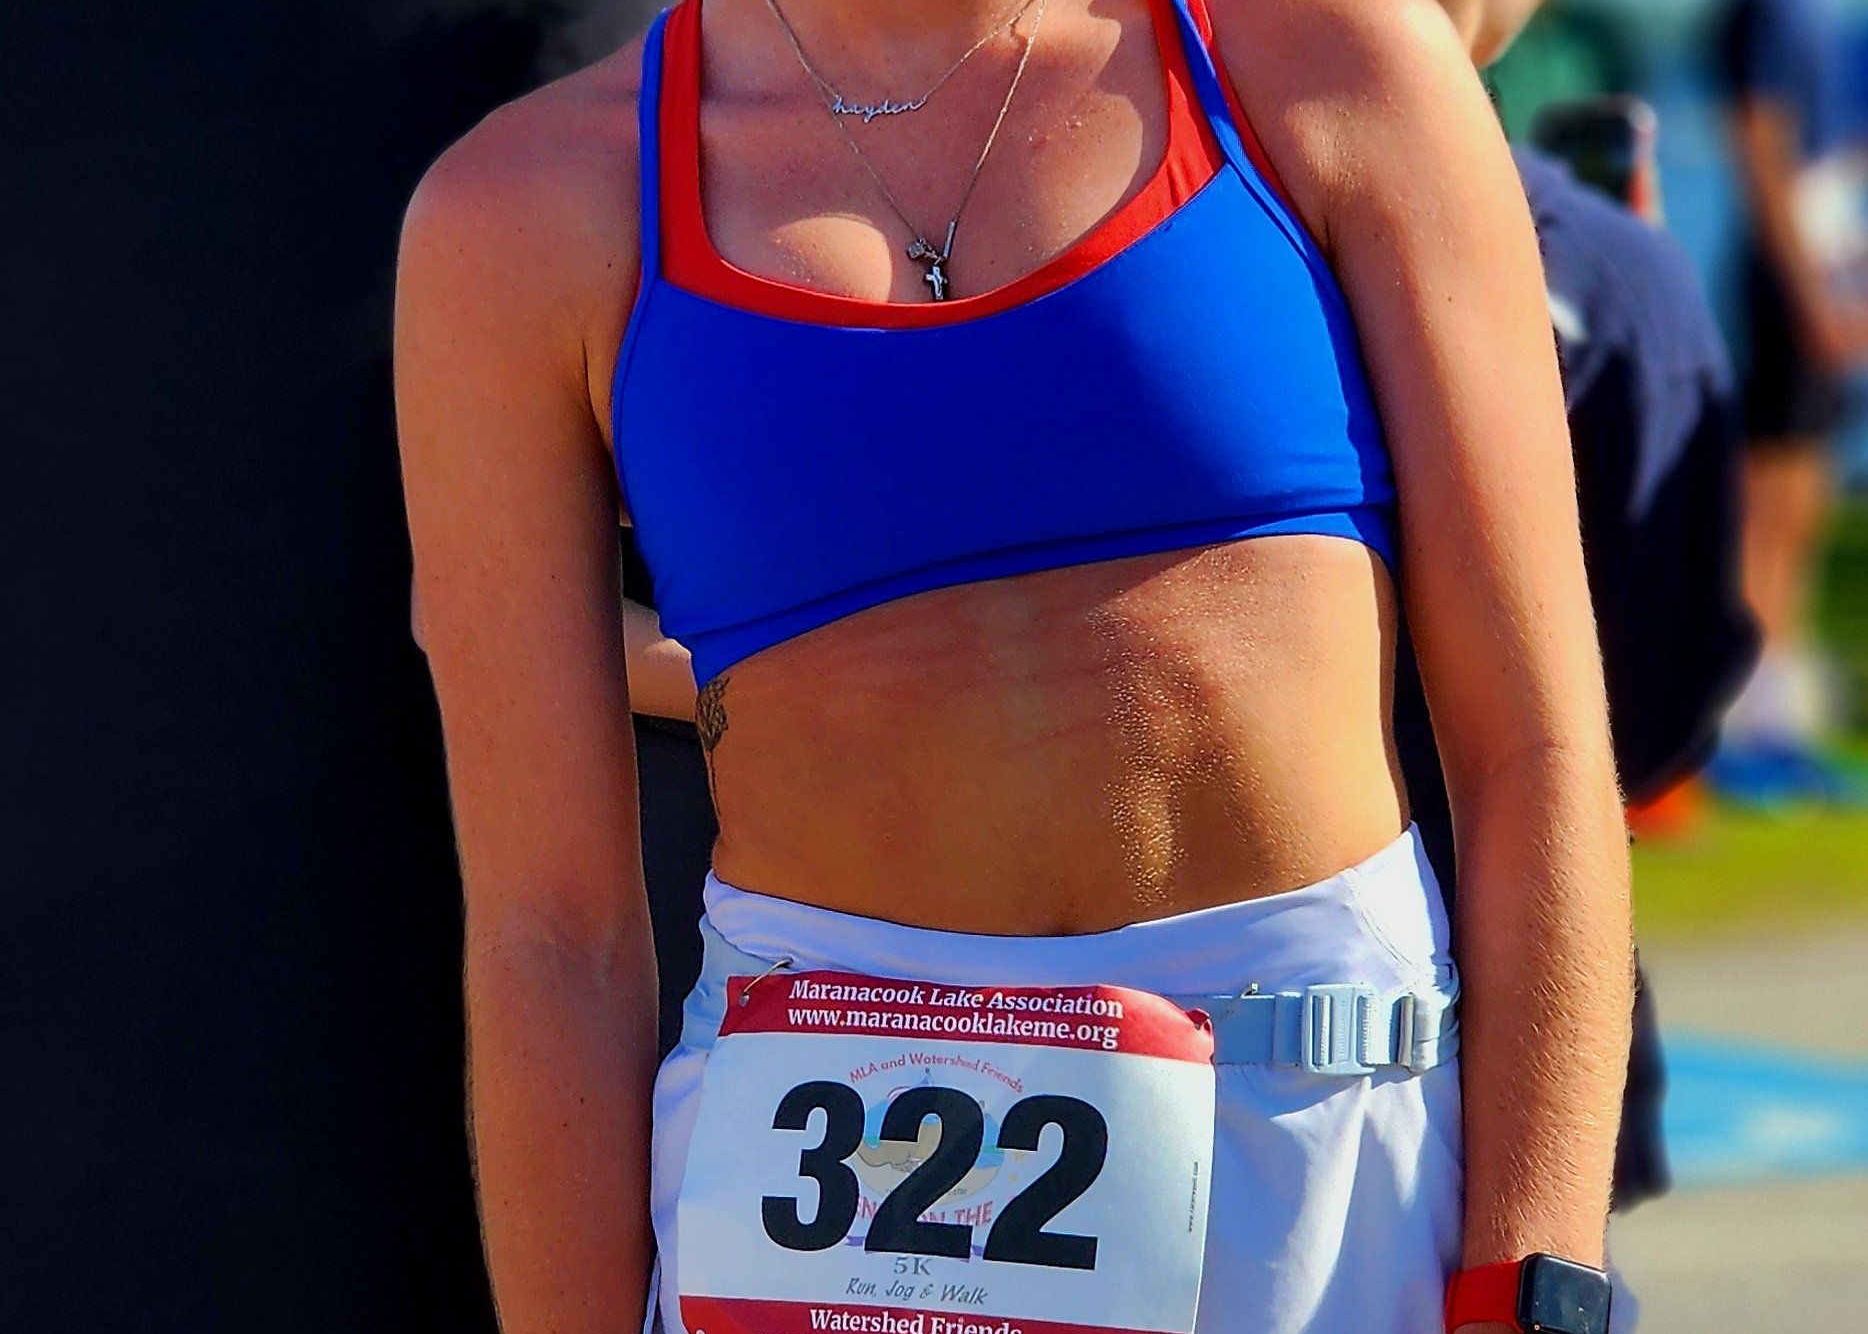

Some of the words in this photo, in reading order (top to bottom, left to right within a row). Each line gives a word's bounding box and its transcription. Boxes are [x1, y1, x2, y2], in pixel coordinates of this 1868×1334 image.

[832, 96, 927, 123] hayden
[789, 979, 926, 1005] Maranacook
[928, 987, 984, 1009] Lake
[988, 991, 1124, 1020] Association
[787, 1007, 1121, 1051] www.maranacooklakeme.org
[849, 1062, 879, 1084] MLA
[880, 1054, 906, 1071] and
[909, 1051, 981, 1073] Watershed
[980, 1061, 1025, 1094] Friends
[760, 1080, 1109, 1272] 322
[893, 1255, 933, 1276] 5K
[885, 1279, 916, 1301] Jog
[919, 1283, 934, 1300] &
[940, 1284, 988, 1305] Walk
